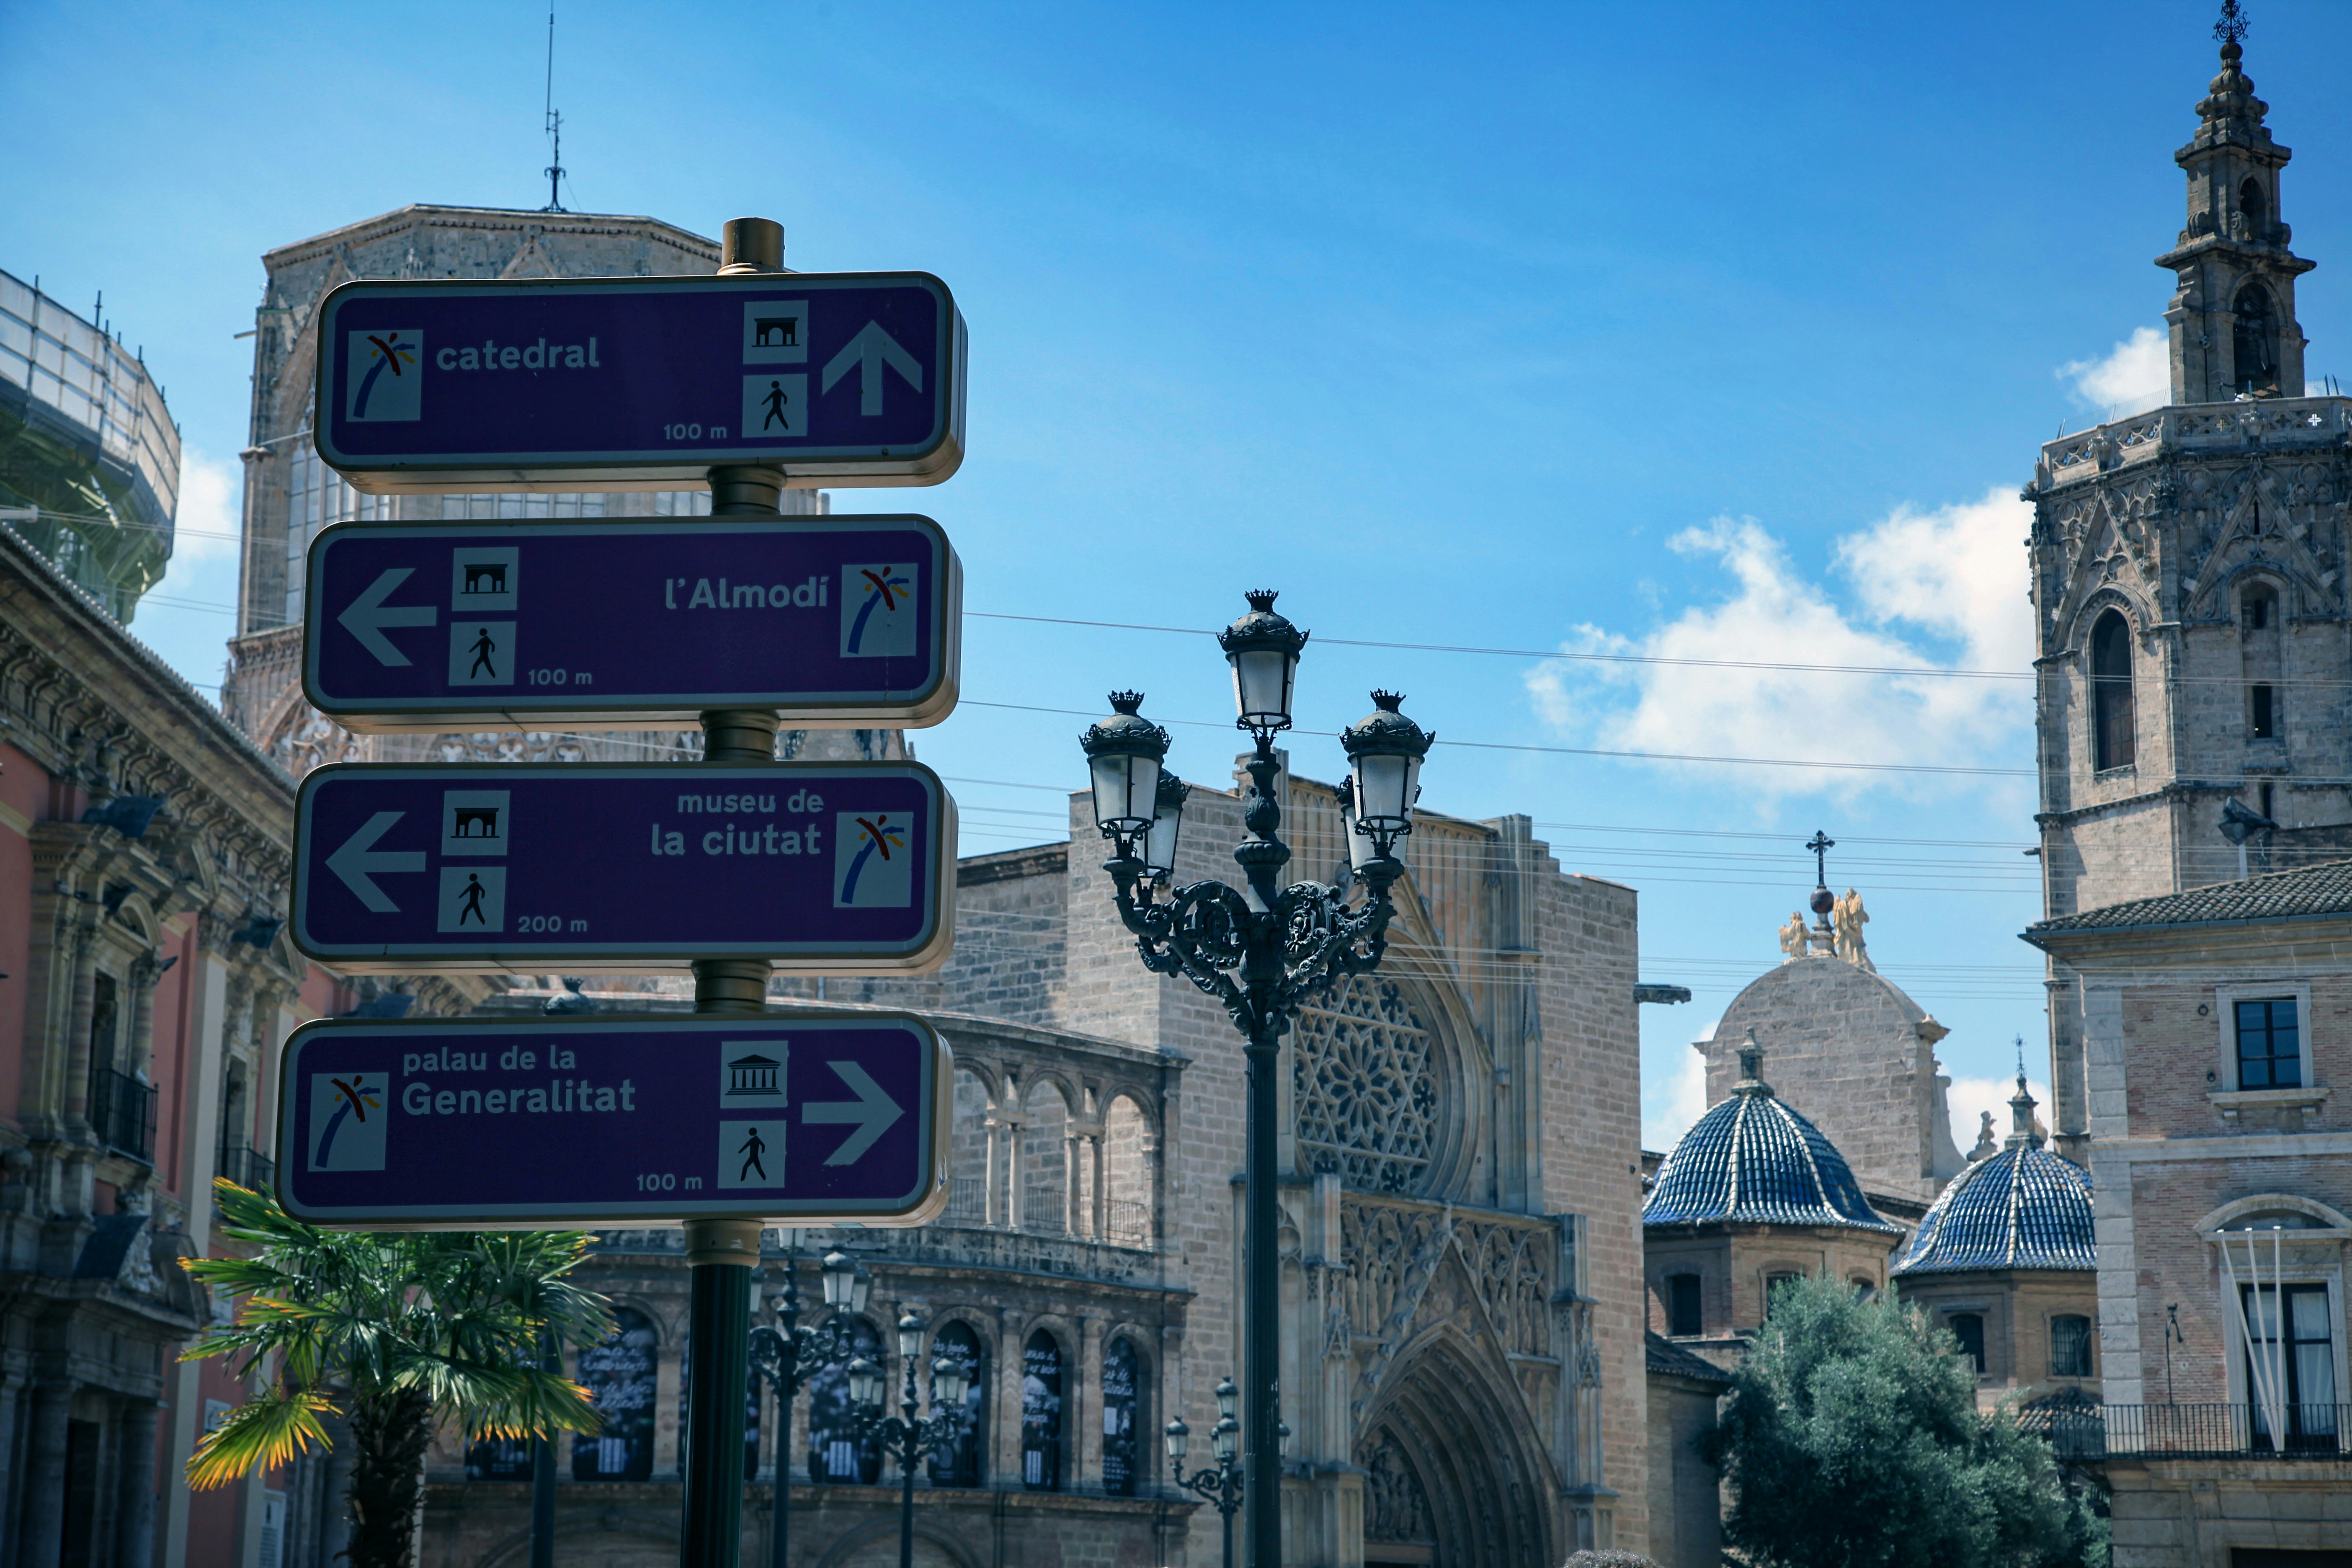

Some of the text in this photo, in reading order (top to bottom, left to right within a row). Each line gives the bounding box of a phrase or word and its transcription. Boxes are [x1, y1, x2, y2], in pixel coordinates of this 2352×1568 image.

[437, 337, 600, 370] catedral
[663, 423, 727, 440] 100 m
[665, 576, 829, 609] l'Almodí
[528, 668, 592, 685] 100 m
[678, 789, 824, 813] museu de
[652, 823, 821, 855] la ciutat
[518, 916, 587, 932] 200 m
[403, 1044, 576, 1076] palau de la
[402, 1079, 635, 1115] Generalitat
[637, 1173, 702, 1191] 100 m
